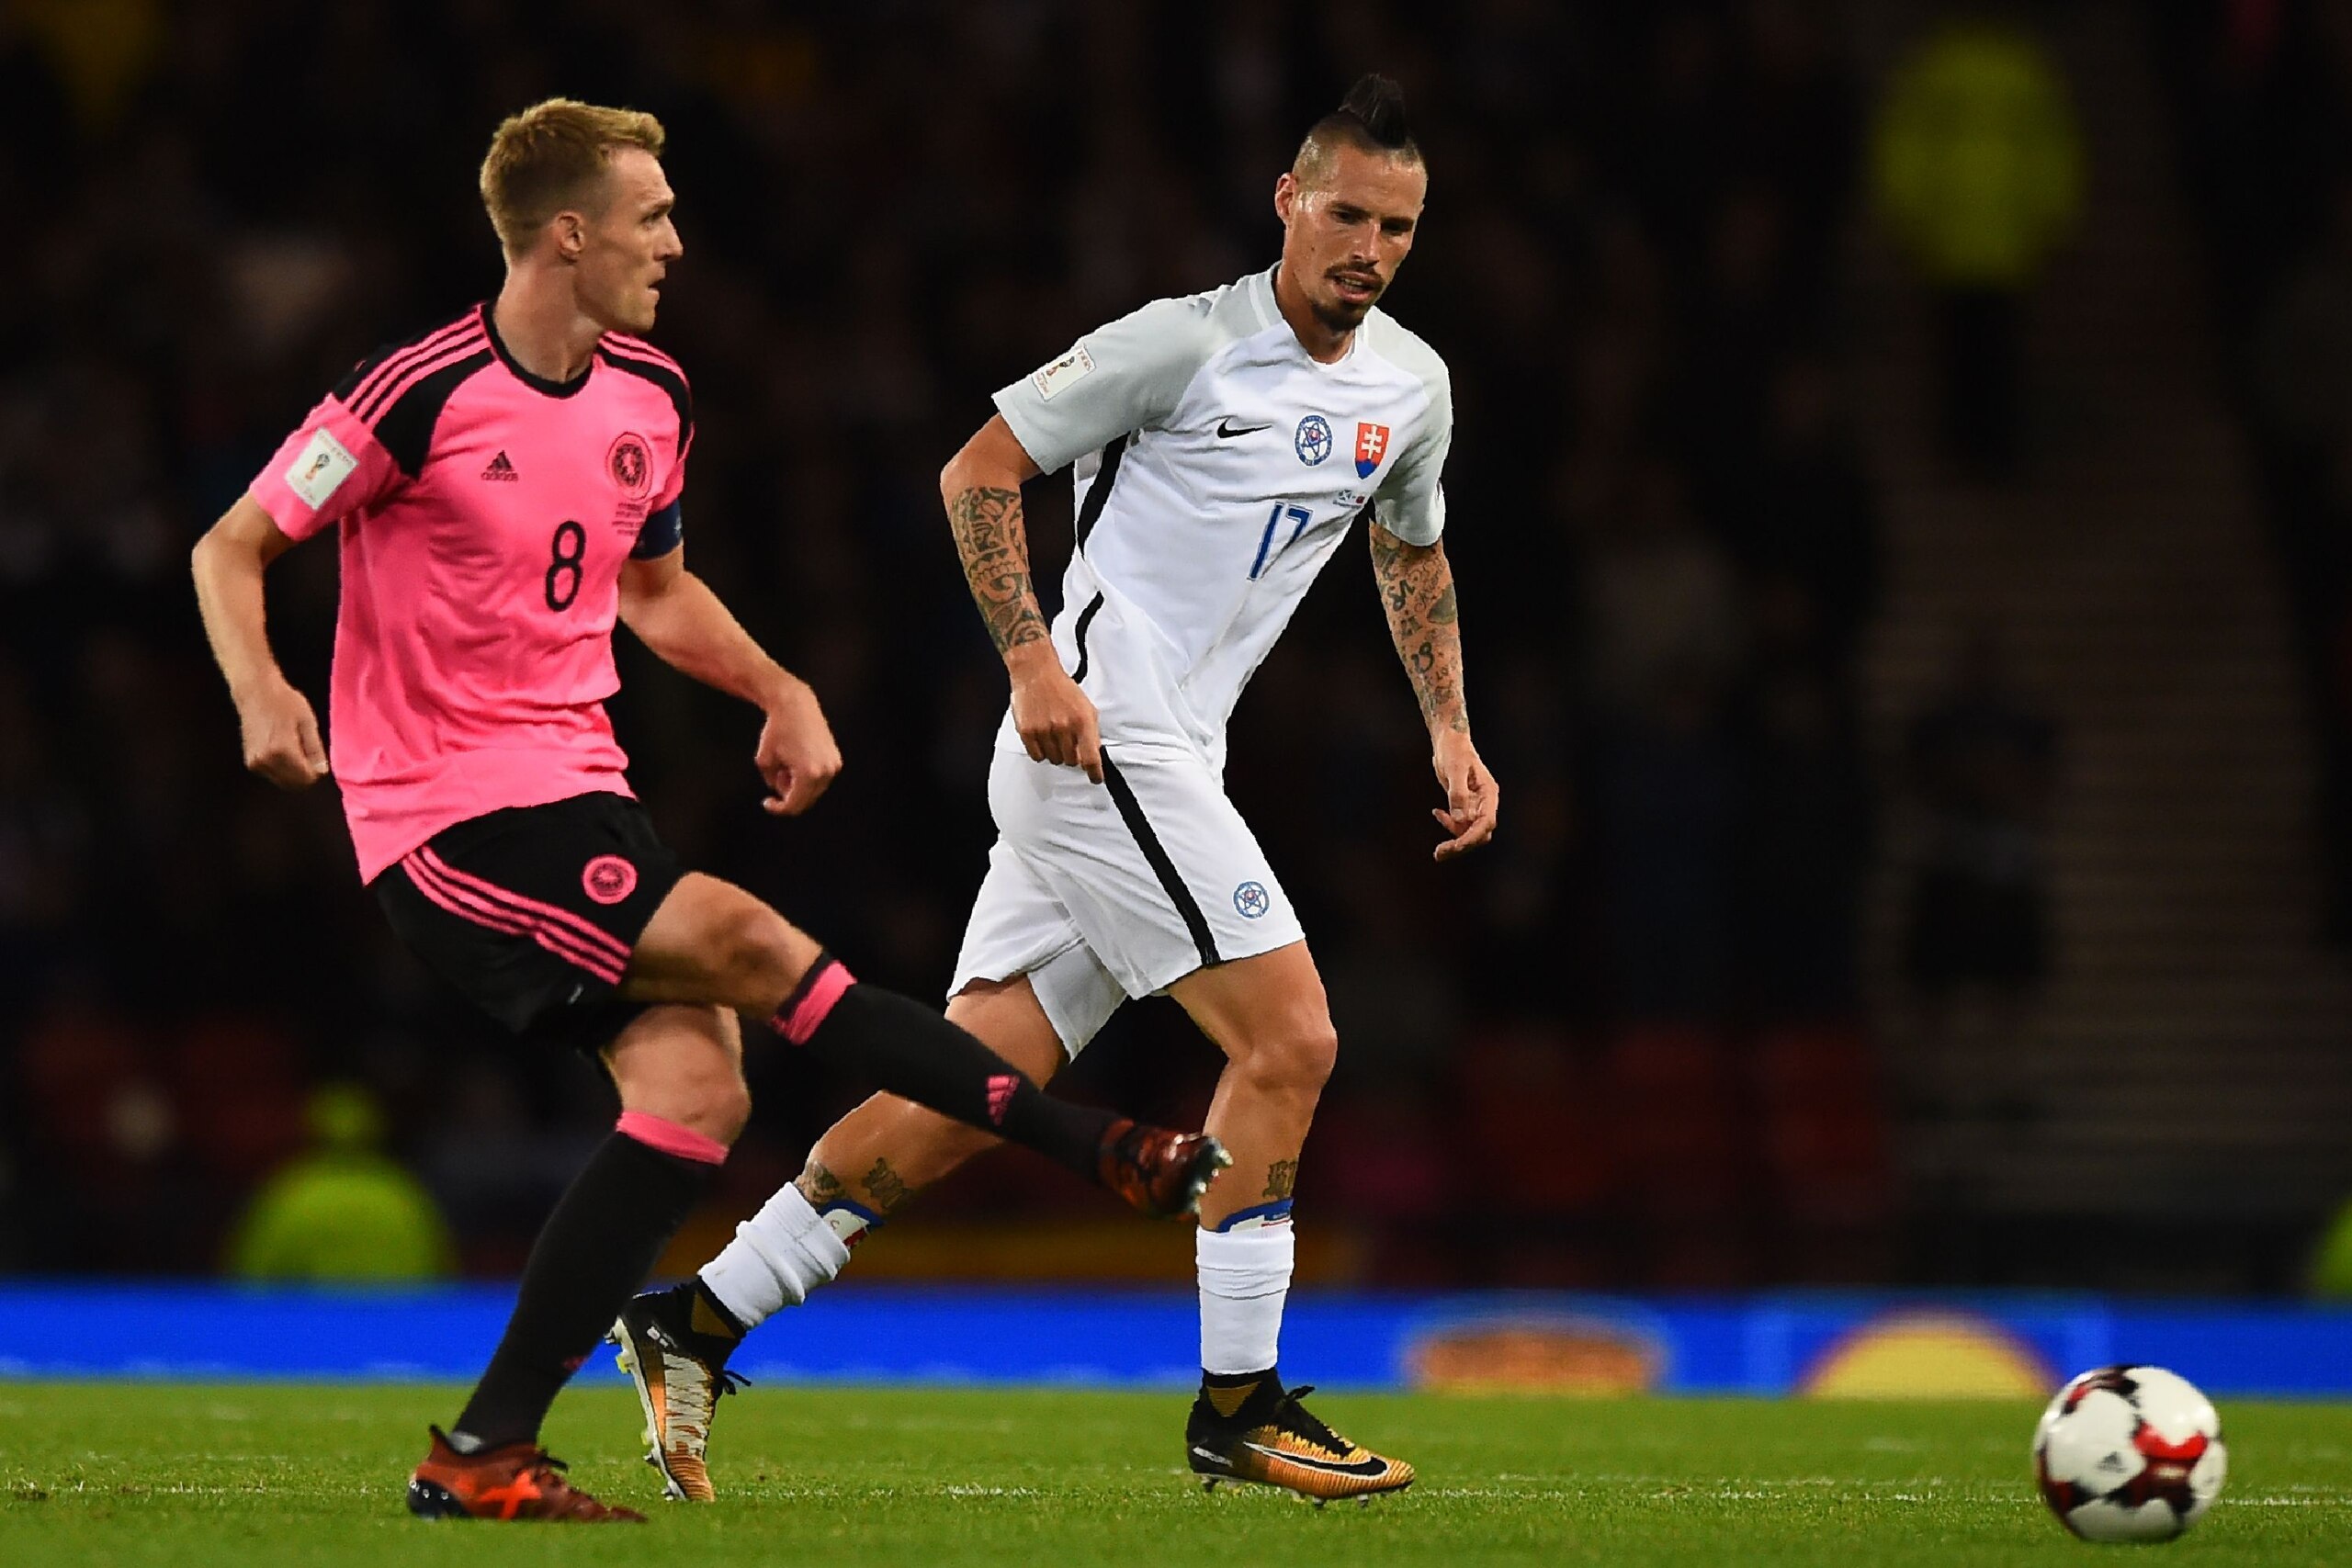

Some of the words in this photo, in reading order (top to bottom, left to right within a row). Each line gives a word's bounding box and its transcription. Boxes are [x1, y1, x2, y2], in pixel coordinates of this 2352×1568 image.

[481, 469, 518, 482] adidas
[546, 521, 586, 612] 8
[1247, 502, 1313, 581] 17
